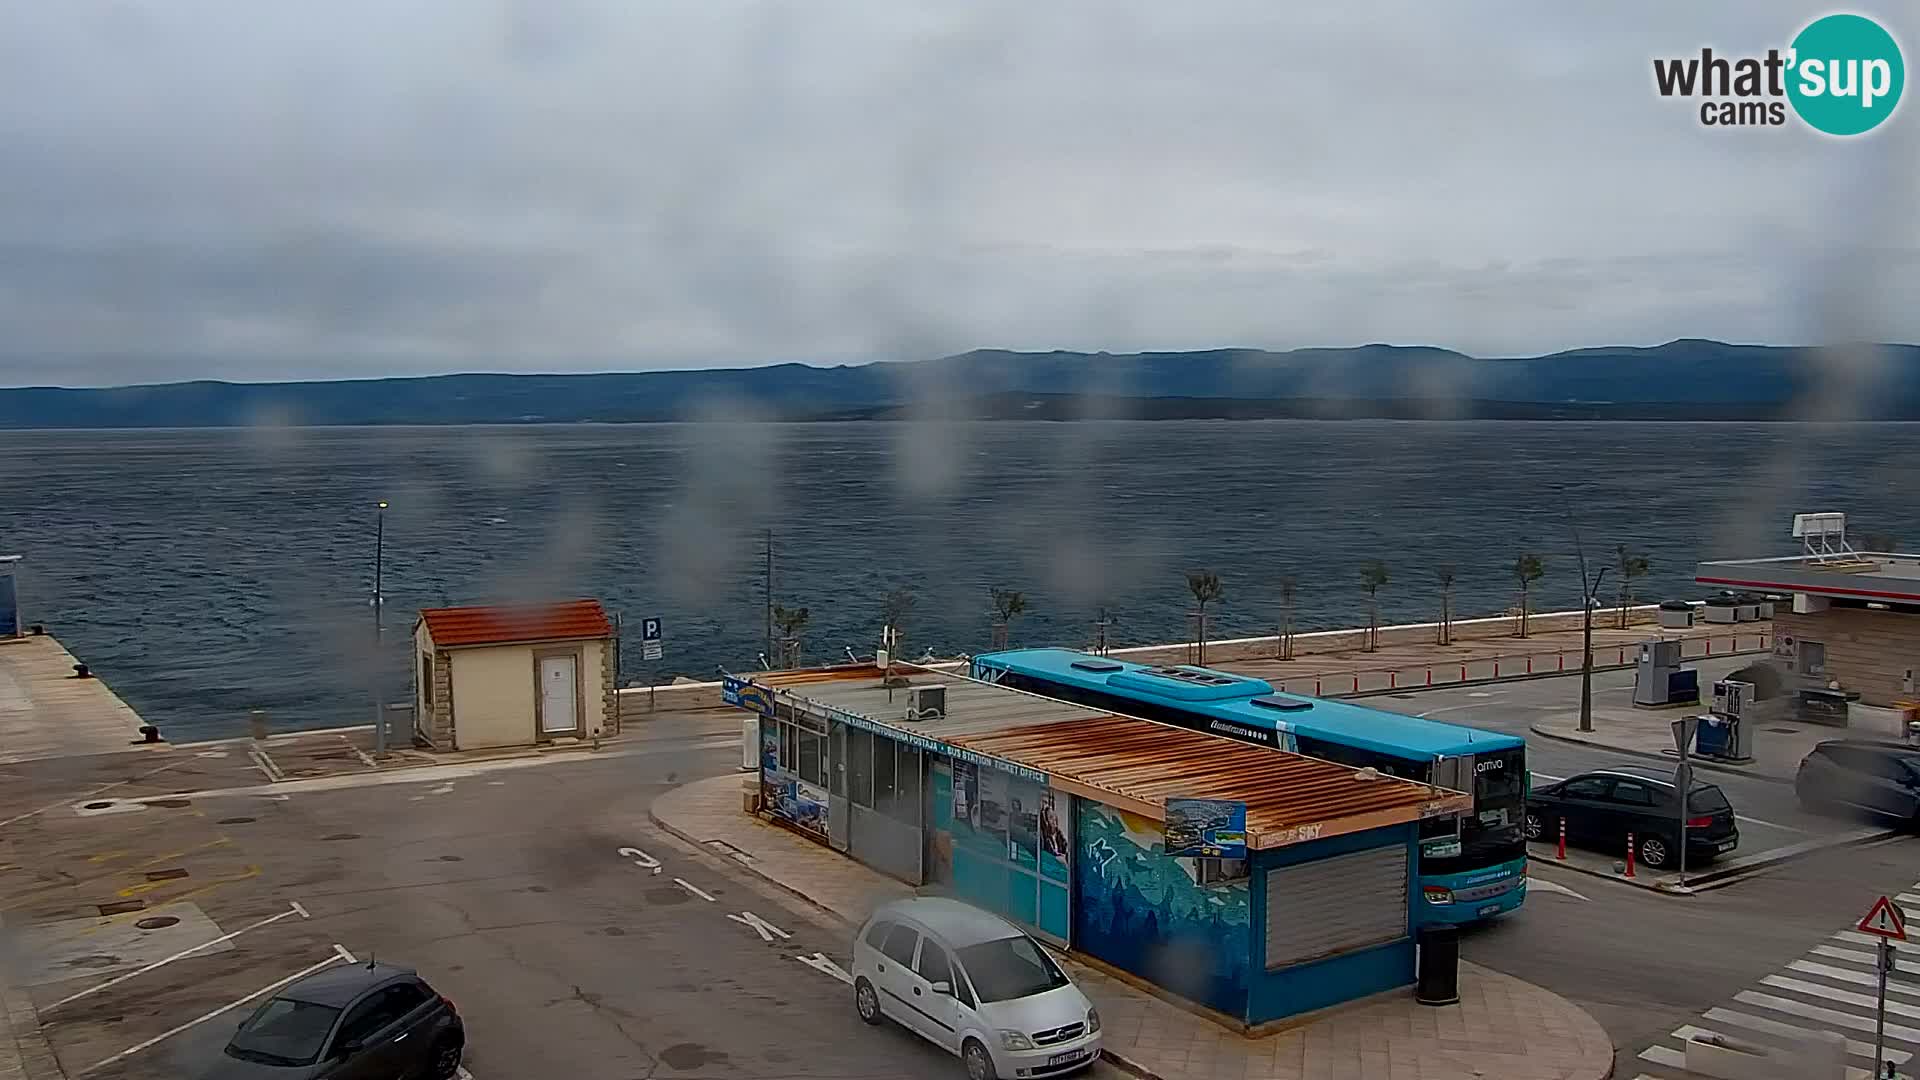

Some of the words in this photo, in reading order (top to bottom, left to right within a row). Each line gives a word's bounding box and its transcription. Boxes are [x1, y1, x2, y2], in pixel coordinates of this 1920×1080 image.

[647, 620, 657, 637] P
[909, 735, 938, 751] POSTAJA
[947, 746, 961, 758] BUS
[962, 751, 991, 766] STATION
[994, 760, 1018, 776] TICKET
[1020, 768, 1045, 783] OFFICE
[1477, 759, 1503, 772] arriva
